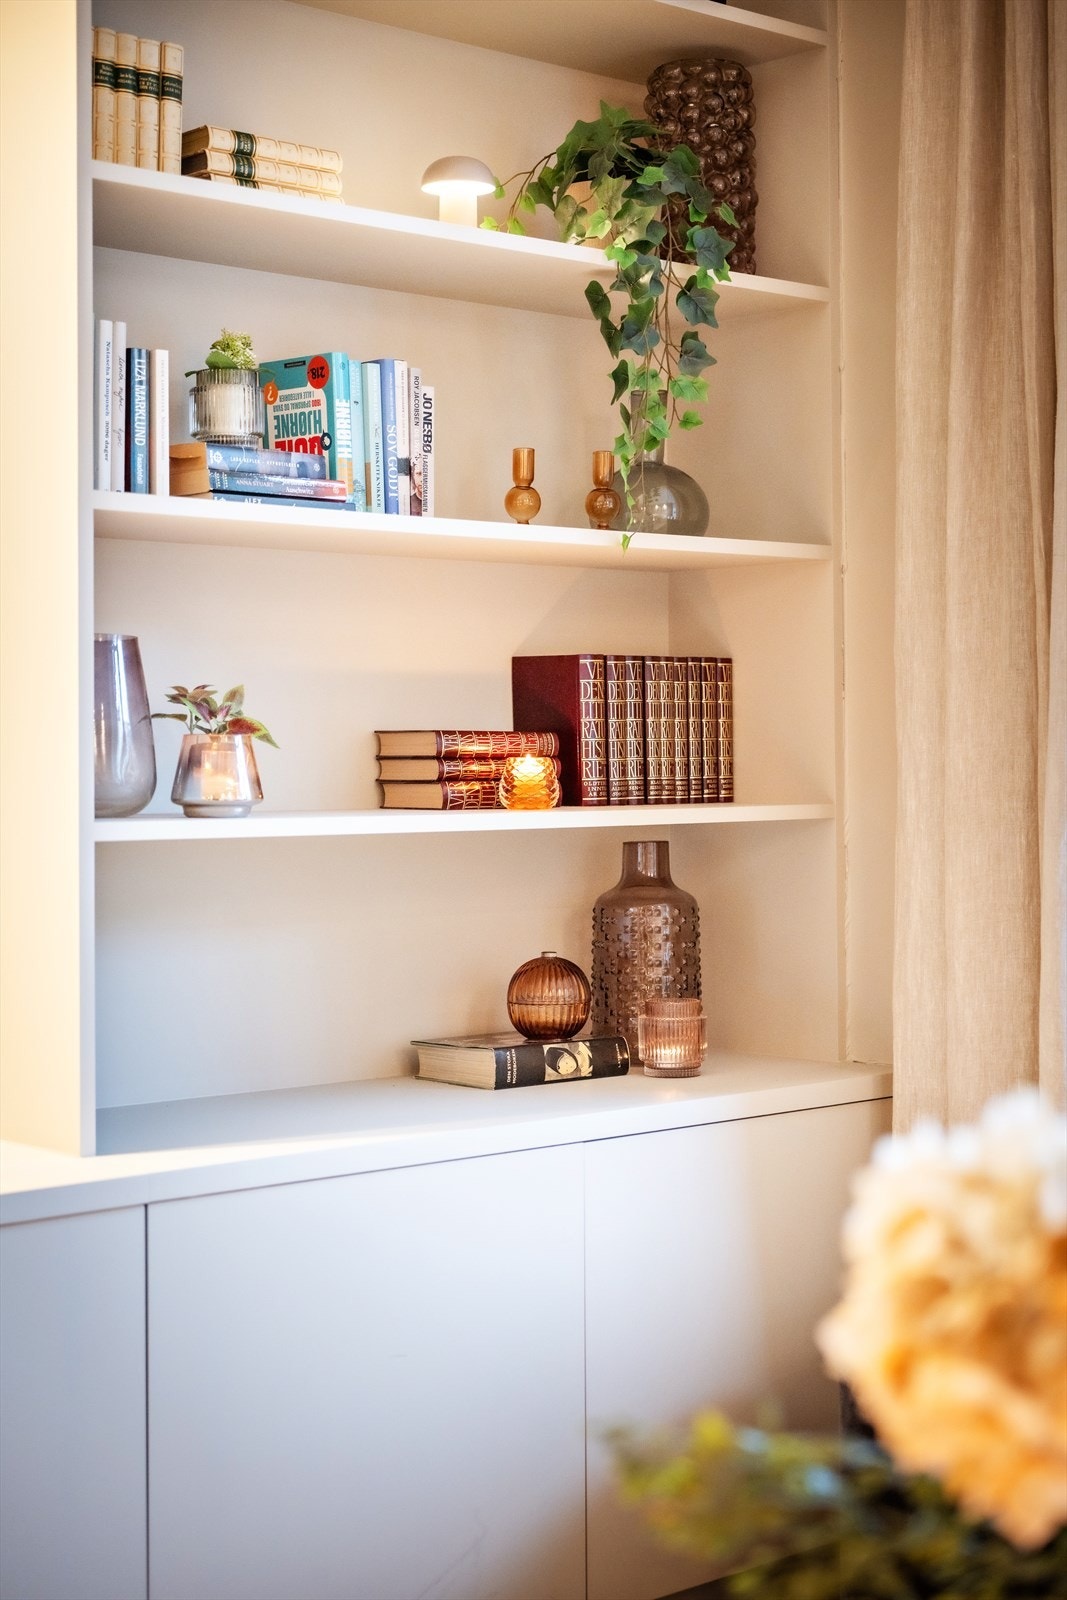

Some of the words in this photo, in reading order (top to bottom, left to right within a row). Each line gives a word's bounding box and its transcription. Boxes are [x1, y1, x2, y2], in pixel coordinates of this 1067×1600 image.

[135, 359, 146, 381] LIZA
[279, 392, 302, 402] KATEGORIER
[422, 393, 432, 410] JO
[134, 385, 146, 446] MARKLUND
[274, 409, 322, 439] HJØRNE
[386, 424, 398, 454] SOV
[422, 411, 433, 455] NESBØ
[388, 460, 398, 500] GODT
[587, 662, 602, 680] VE
[612, 664, 624, 680] VE
[629, 663, 641, 680] VE
[581, 682, 604, 700] DEN
[608, 682, 625, 700] DEN
[628, 682, 642, 700] DEN
